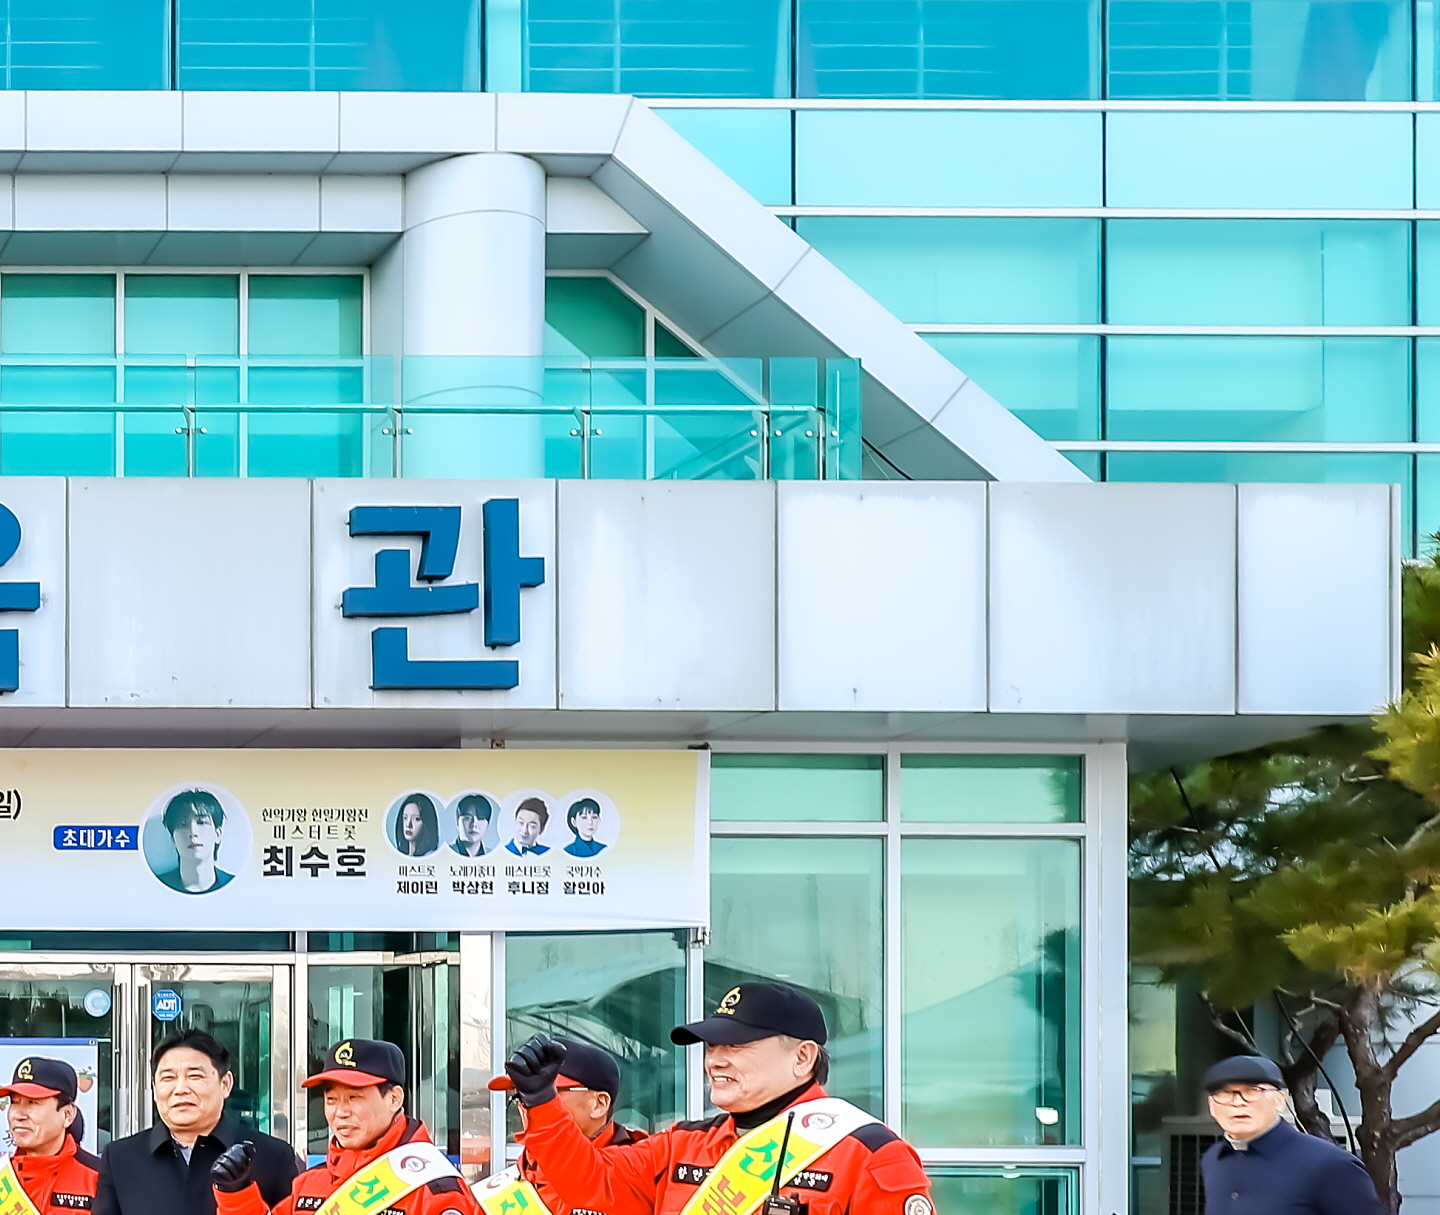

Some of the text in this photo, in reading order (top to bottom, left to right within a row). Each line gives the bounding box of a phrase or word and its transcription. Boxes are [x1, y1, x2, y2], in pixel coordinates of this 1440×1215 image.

[62, 829, 131, 849] 초대가수
[273, 824, 358, 841] 미스터트롯
[262, 845, 367, 878] 최수호
[505, 865, 552, 878] 미스터트롯
[396, 881, 438, 896] 제이린
[452, 880, 494, 896] 박상현
[156, 999, 176, 1010] ADT
